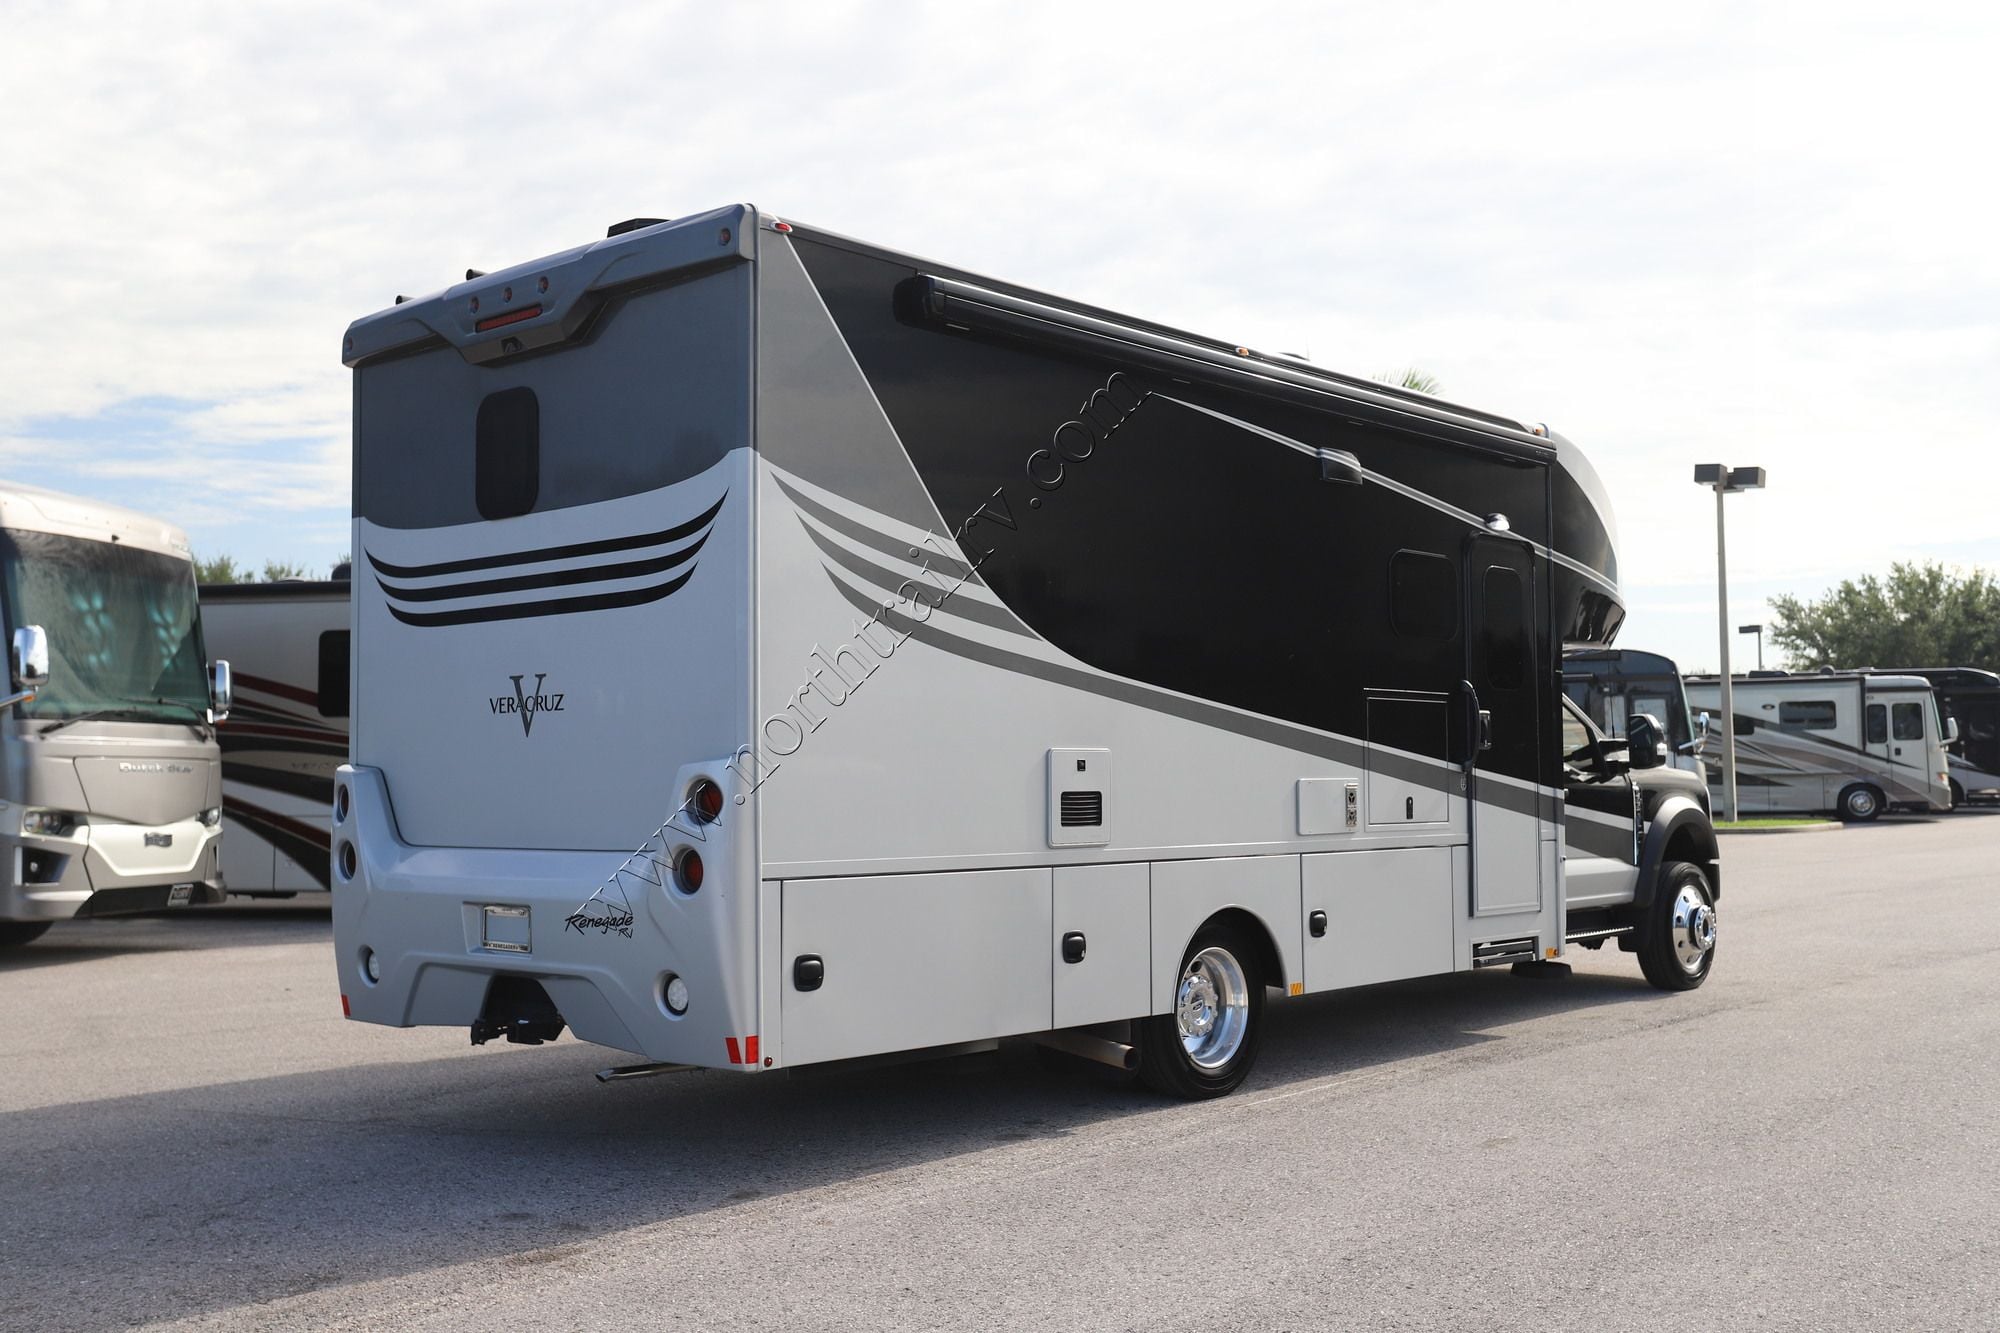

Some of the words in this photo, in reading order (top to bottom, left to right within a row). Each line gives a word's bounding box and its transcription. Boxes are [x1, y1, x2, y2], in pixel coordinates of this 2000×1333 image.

[489, 694, 565, 715] VERACRUZ
[564, 911, 634, 936] Renegade
[617, 927, 634, 940] RV
